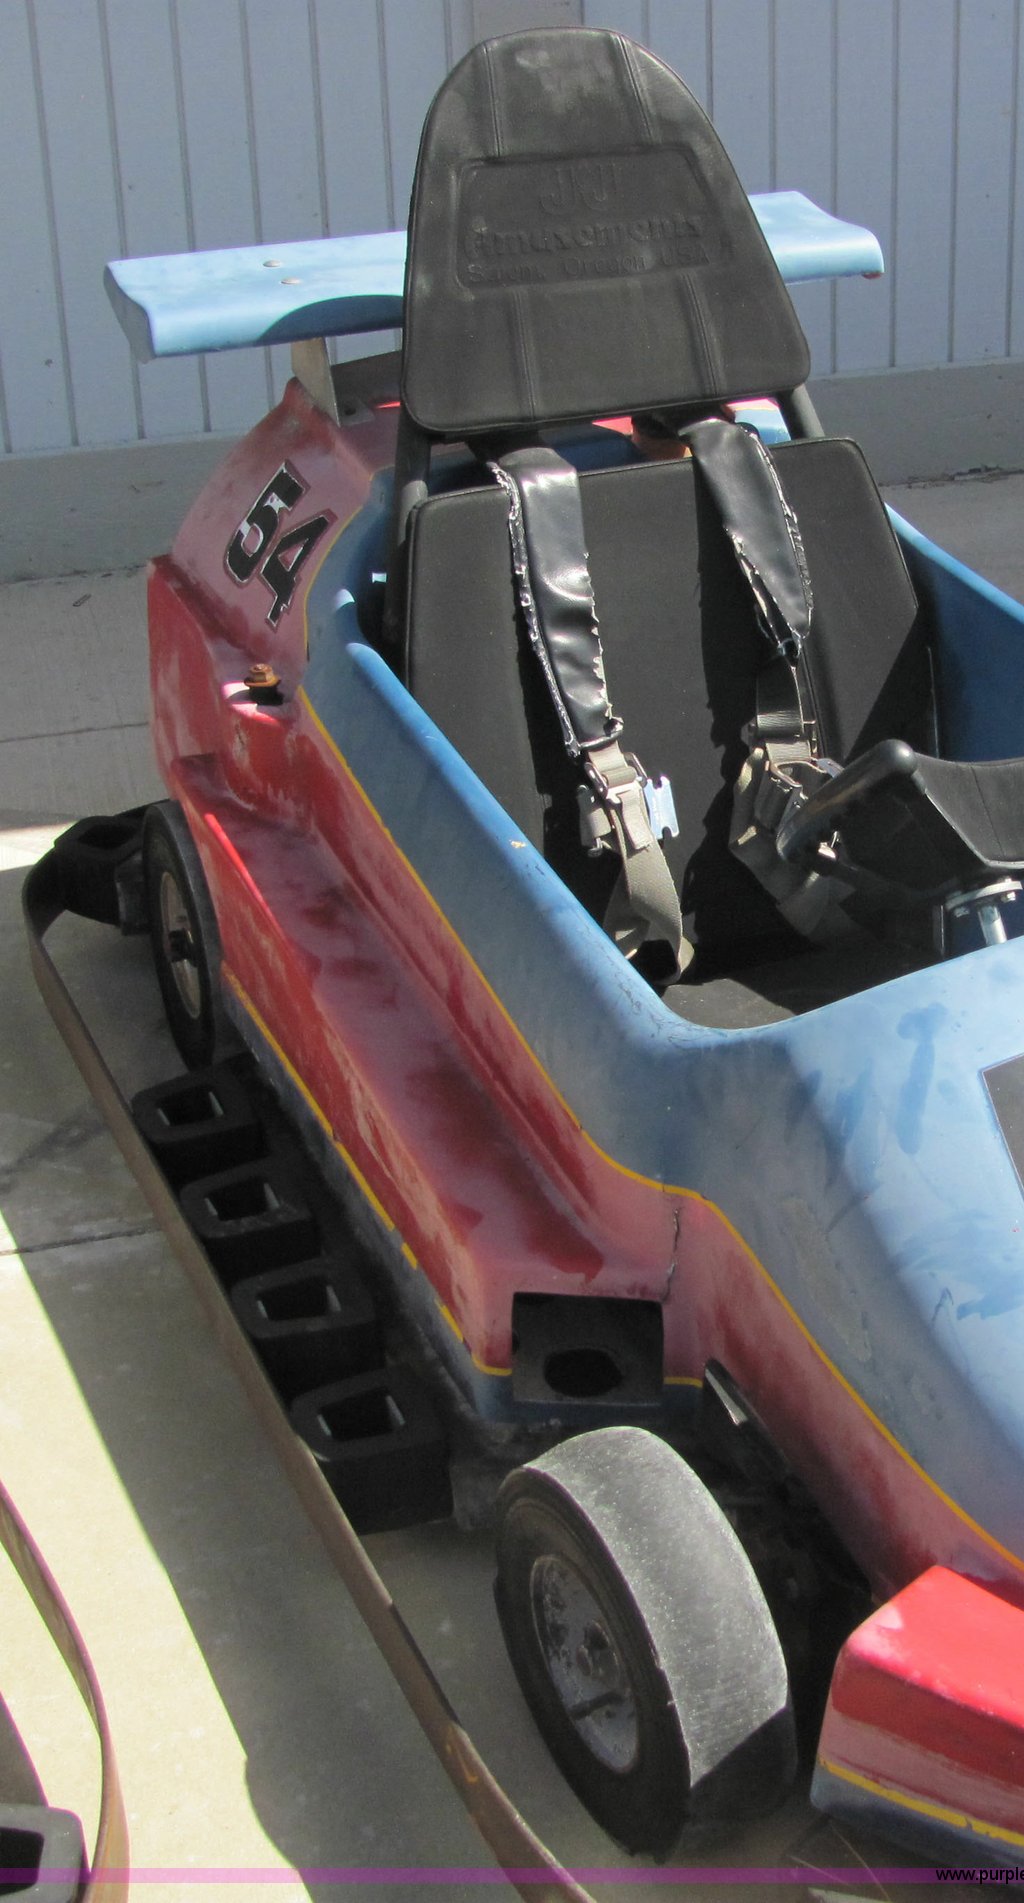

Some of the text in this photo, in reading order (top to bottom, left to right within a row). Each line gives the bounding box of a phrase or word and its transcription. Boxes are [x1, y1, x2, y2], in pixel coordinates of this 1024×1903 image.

[464, 212, 703, 260] Amusements
[561, 253, 648, 279] Oregon
[658, 242, 711, 268] USA
[223, 459, 335, 631] 54
